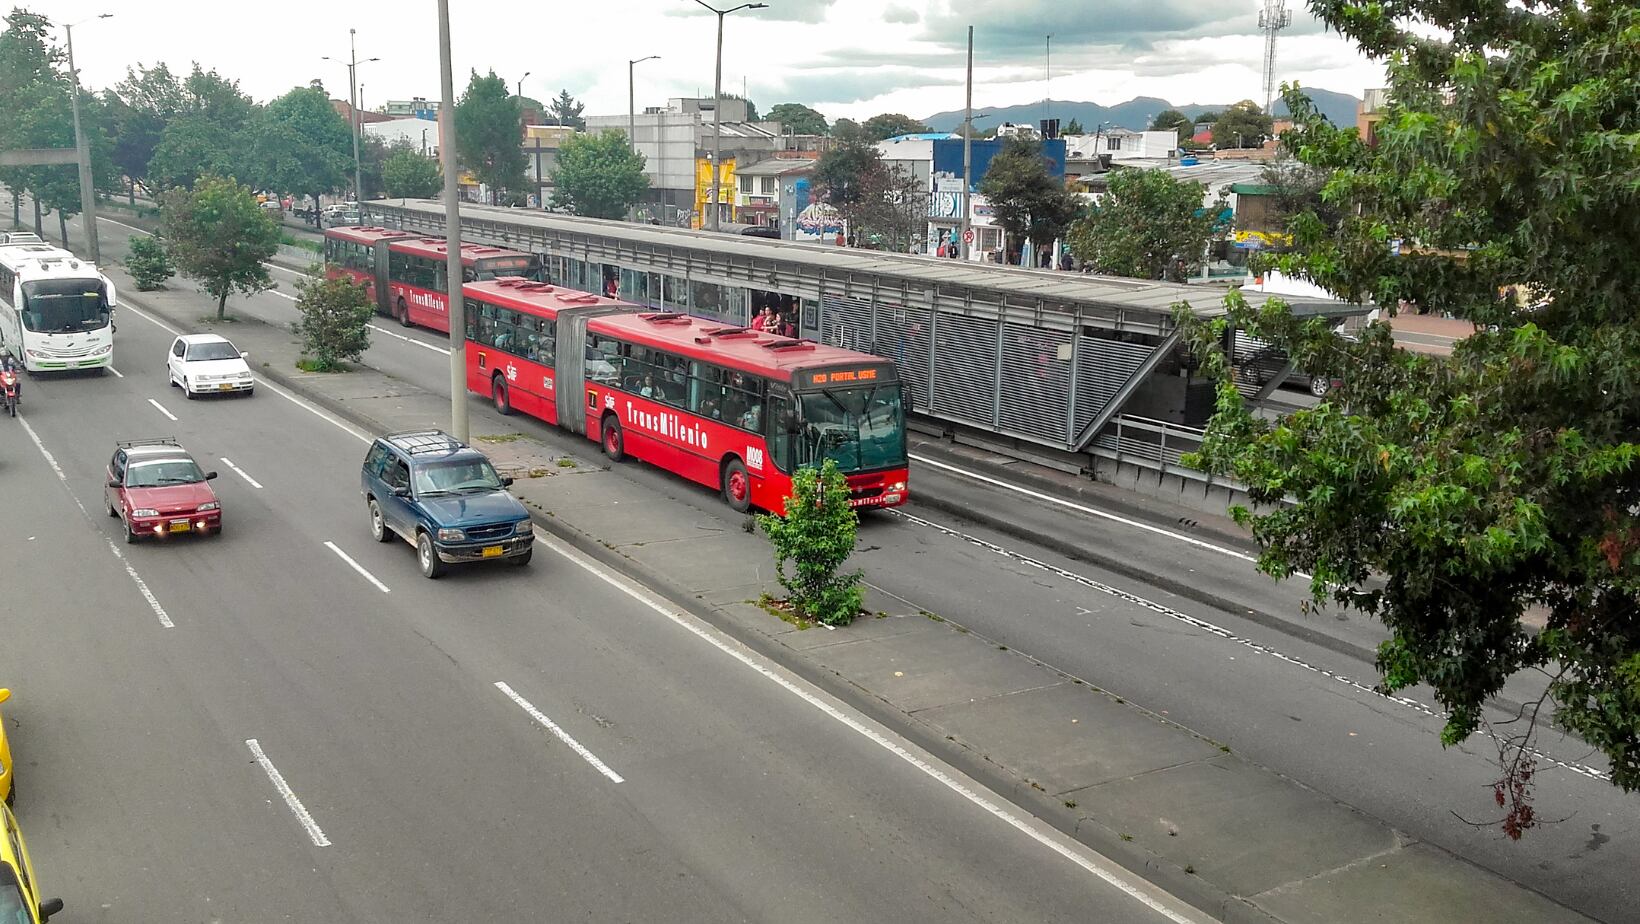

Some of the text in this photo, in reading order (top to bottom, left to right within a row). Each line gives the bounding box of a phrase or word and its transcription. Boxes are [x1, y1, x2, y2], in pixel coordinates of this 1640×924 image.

[410, 289, 445, 311] TransMilenio
[831, 371, 857, 381] PORTAL
[858, 369, 877, 379] USME
[626, 401, 708, 449] TransMilenio
